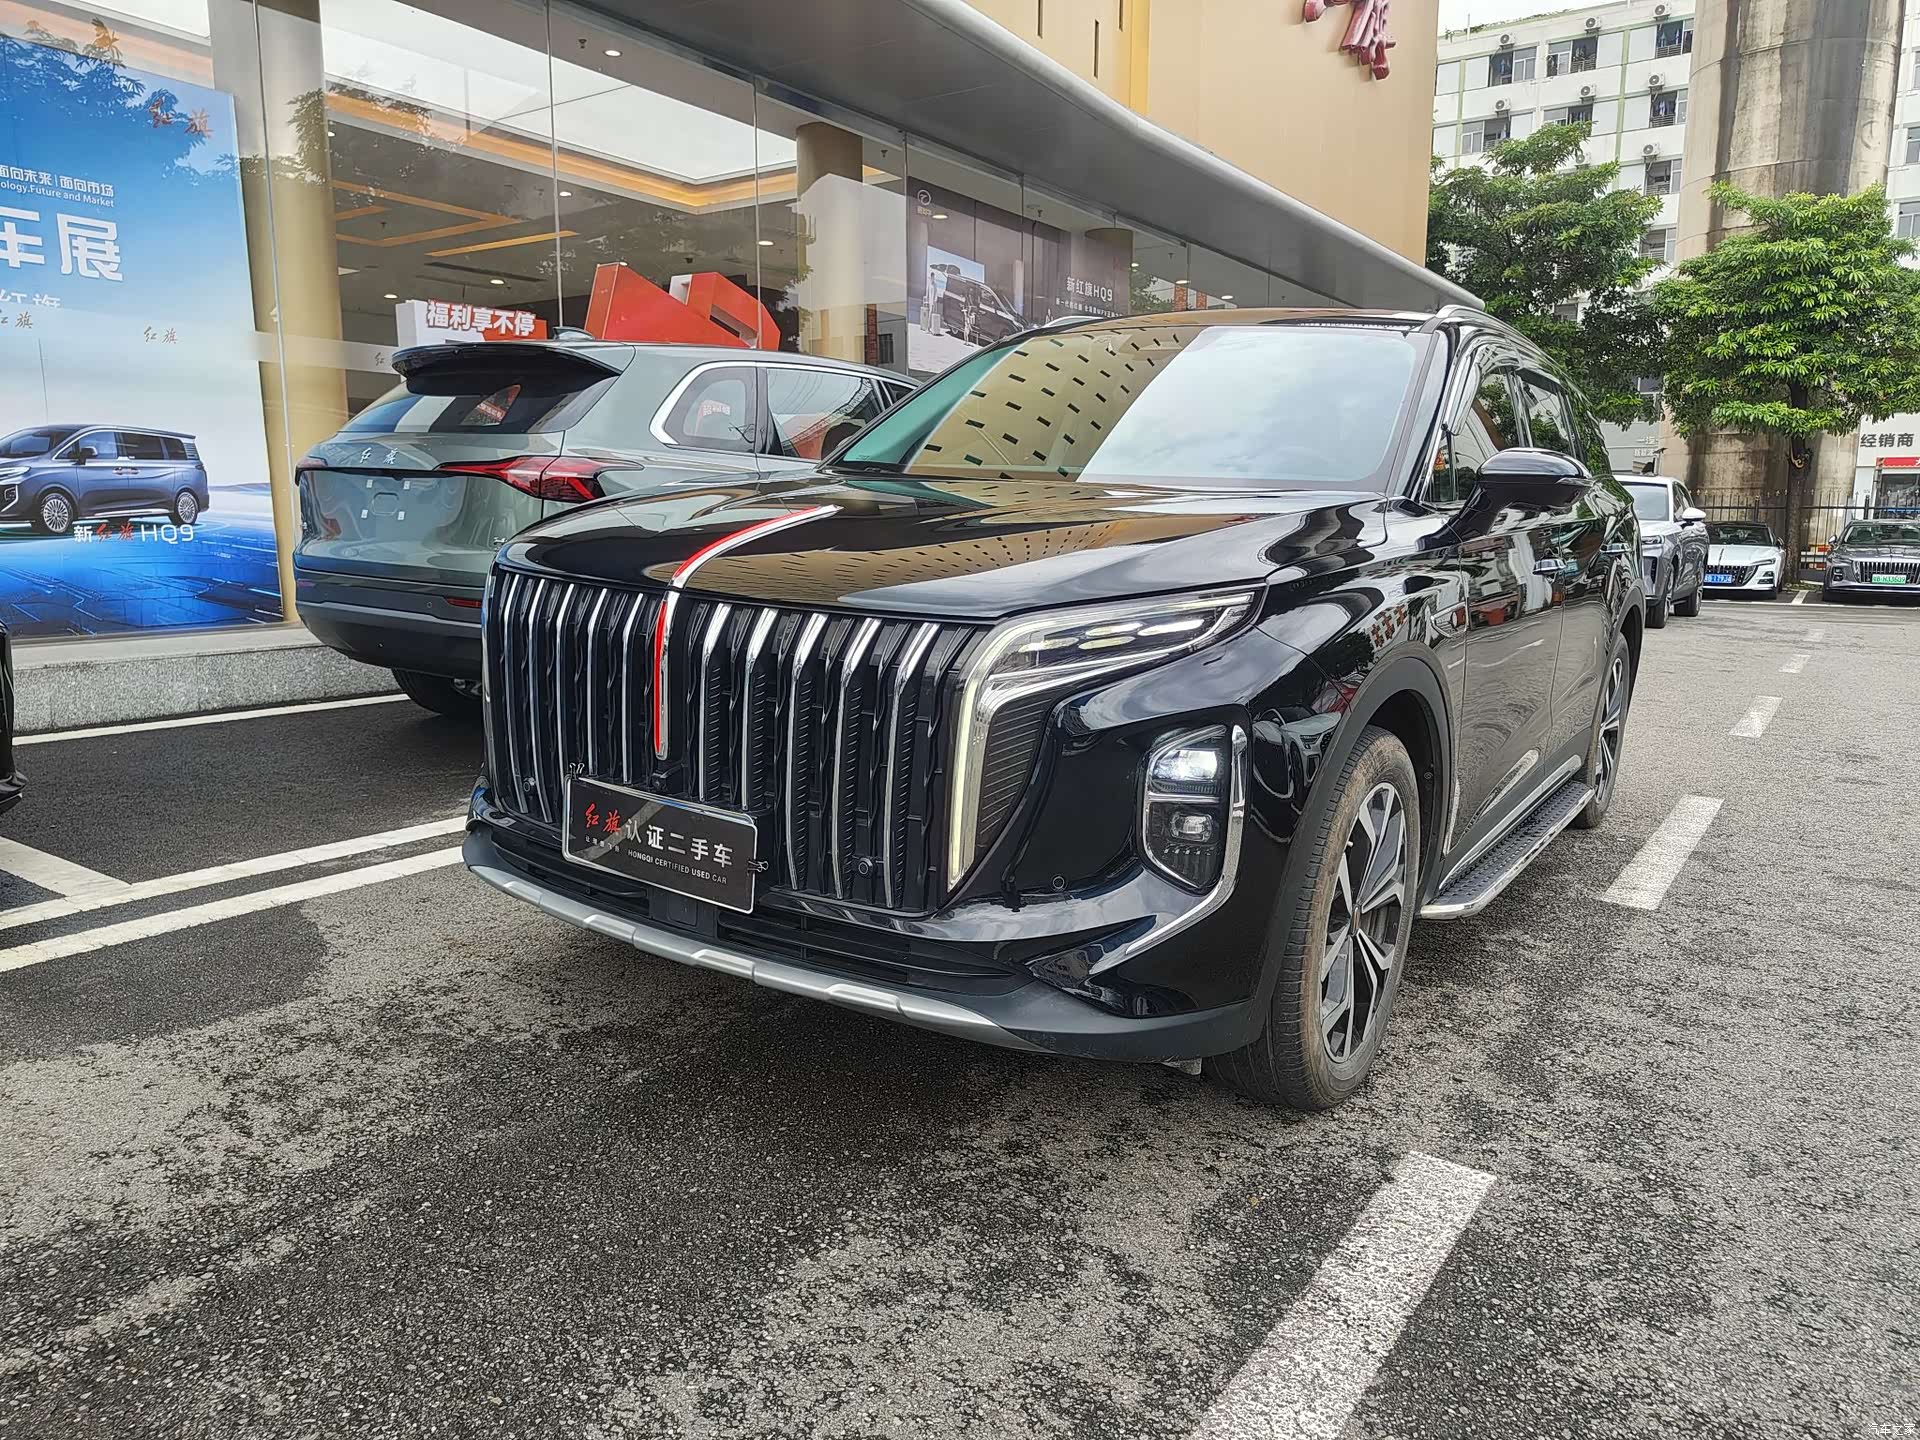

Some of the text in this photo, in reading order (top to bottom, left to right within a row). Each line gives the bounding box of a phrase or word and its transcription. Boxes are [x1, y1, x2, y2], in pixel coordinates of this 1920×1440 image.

[59, 175, 114, 197] 面向市场
[63, 191, 81, 202] and
[83, 193, 114, 208] Market
[426, 301, 537, 337] 福利享不停
[143, 325, 179, 345] 红旗
[1860, 432, 1915, 448] 经销商
[140, 523, 195, 545] HQ9
[628, 849, 728, 885] HONGQI CERTIFIED USED CAR
